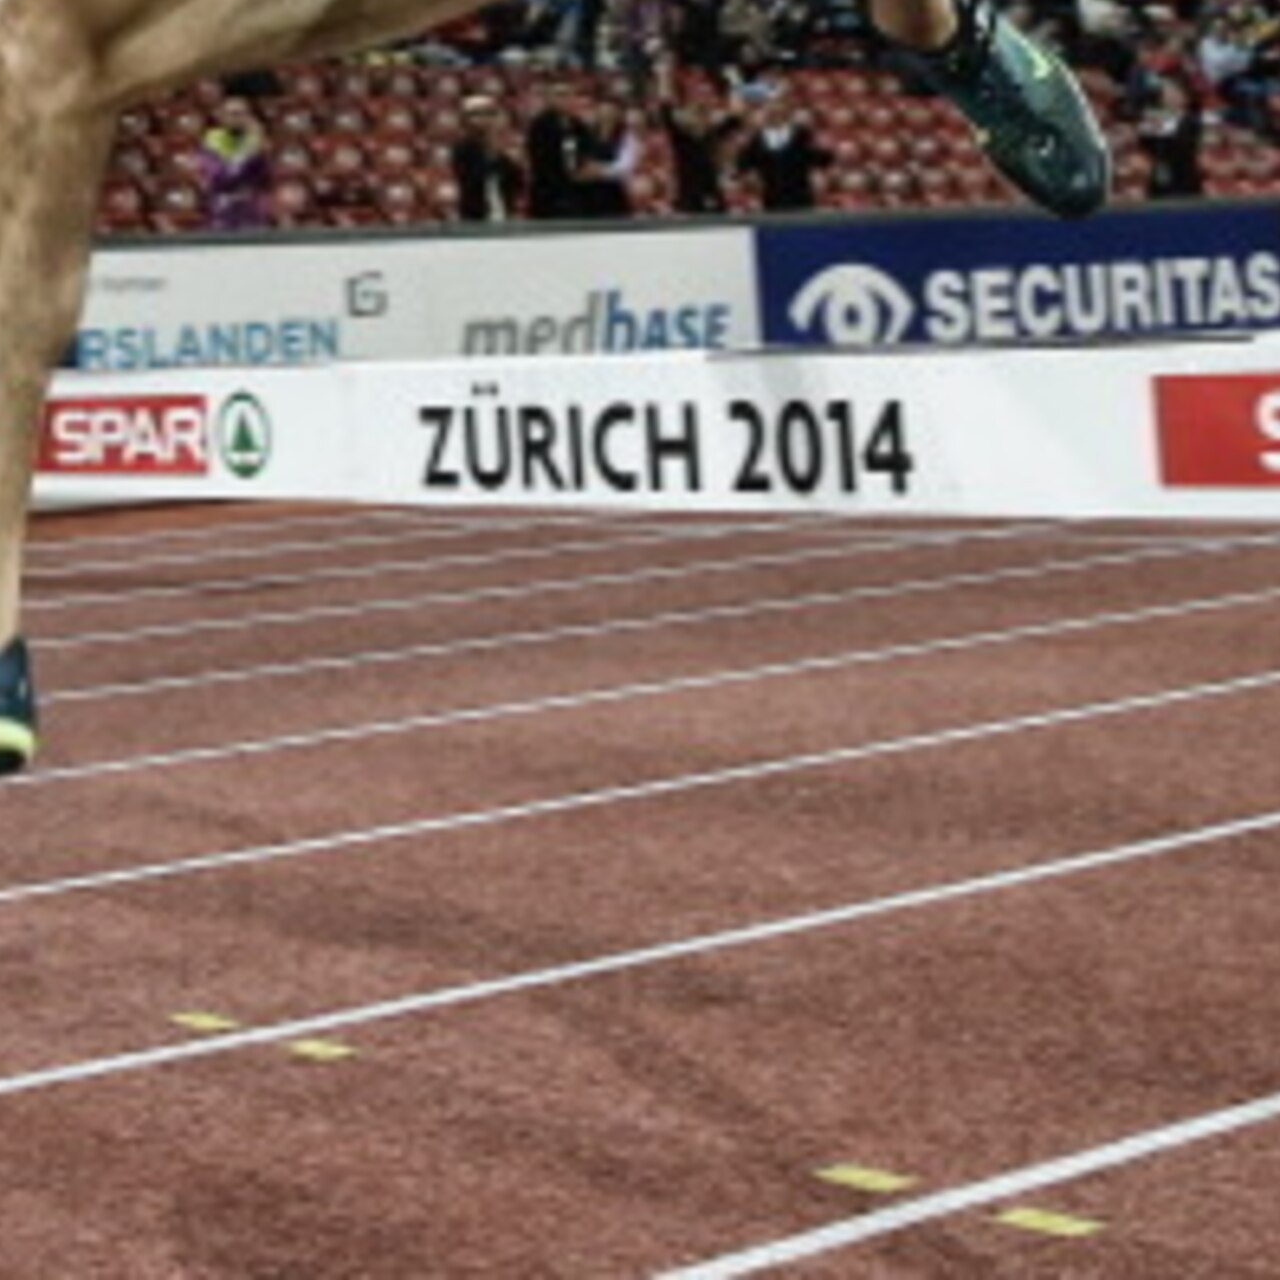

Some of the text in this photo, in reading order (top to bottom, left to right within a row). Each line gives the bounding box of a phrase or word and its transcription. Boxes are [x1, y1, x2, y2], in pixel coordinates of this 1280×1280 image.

[50, 408, 207, 466] SPAR
[419, 382, 913, 495] ZÜRICH 2014
